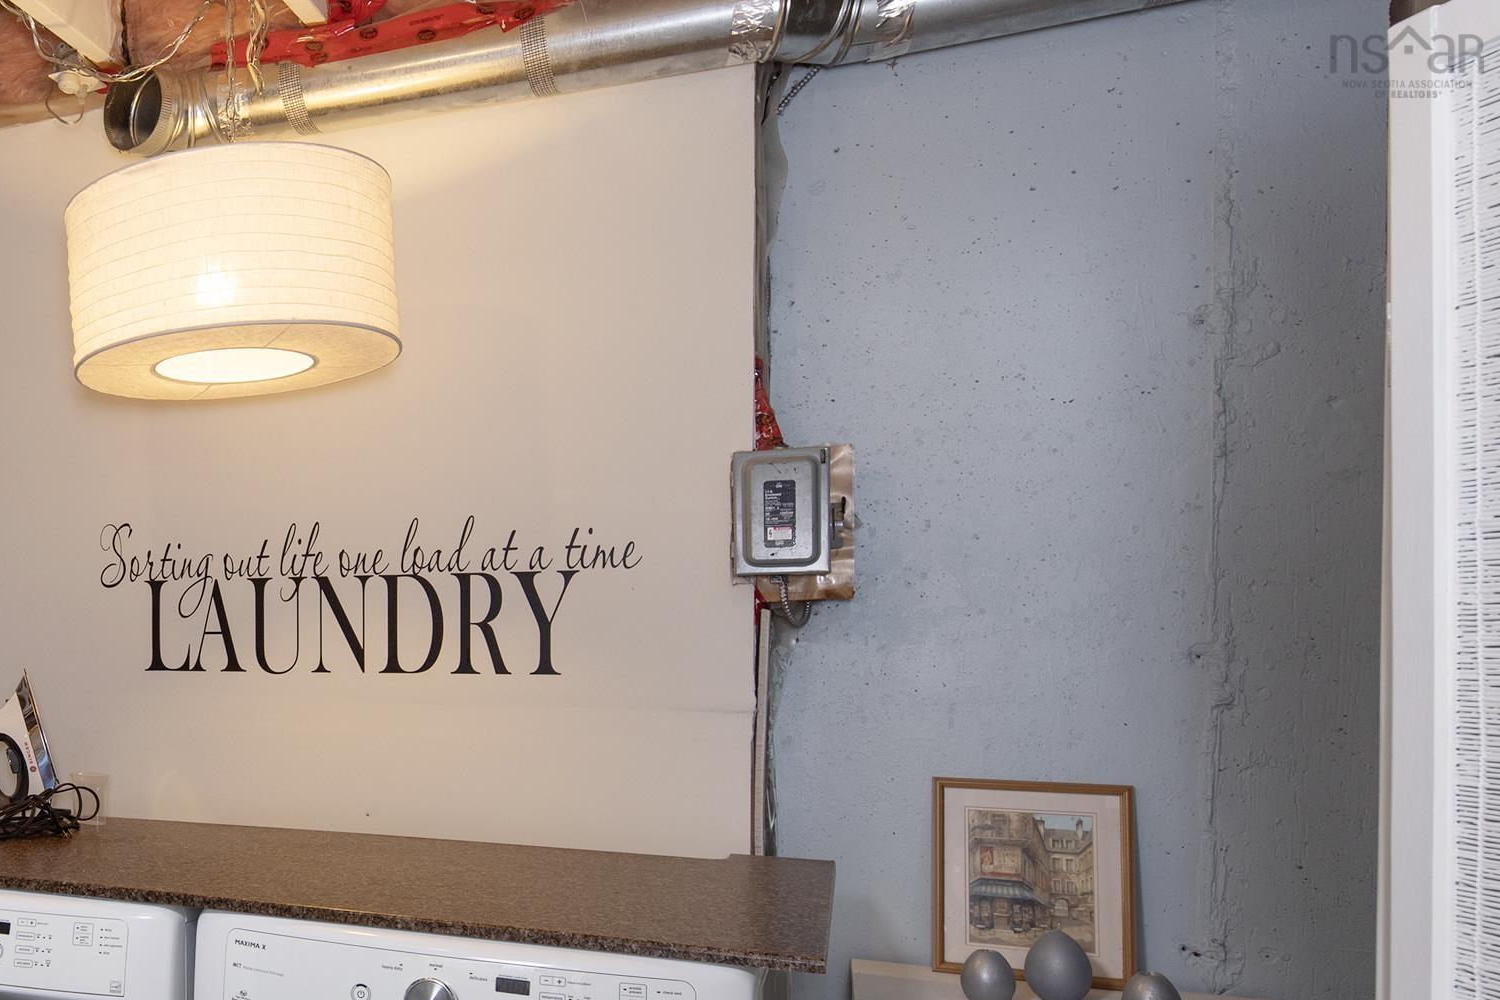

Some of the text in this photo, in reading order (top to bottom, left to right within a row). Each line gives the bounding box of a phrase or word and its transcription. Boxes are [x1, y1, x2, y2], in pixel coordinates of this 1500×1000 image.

[100, 515, 642, 619] Sorting out life one load at a time
[144, 570, 580, 675] LAUNDRY
[235, 939, 260, 949] MAXIMA
